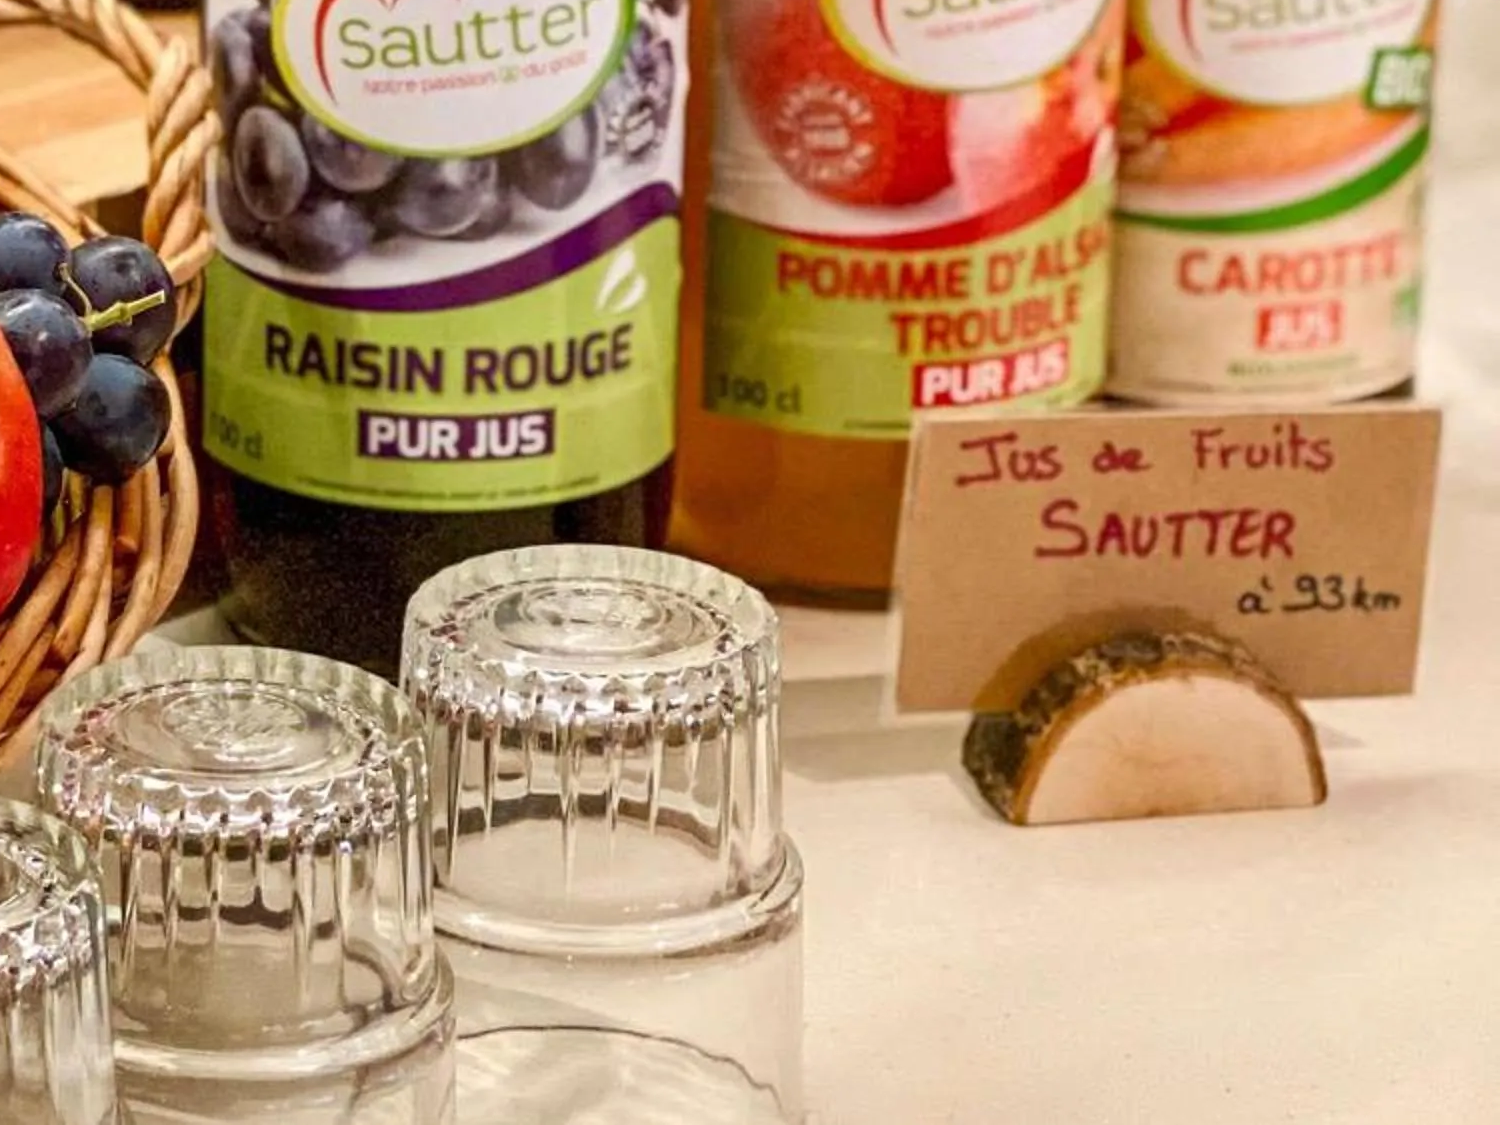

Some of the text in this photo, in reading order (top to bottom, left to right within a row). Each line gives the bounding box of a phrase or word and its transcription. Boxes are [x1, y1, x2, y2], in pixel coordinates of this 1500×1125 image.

[777, 249, 971, 301] POMME
[890, 283, 1082, 357] TROUBLE
[265, 323, 634, 394] RAISIN ROUGE
[920, 340, 1067, 405] PUR JUS
[367, 414, 548, 459] PUR JUS
[956, 425, 1336, 487] Jus de Fruits
[1034, 498, 1297, 559] SAUTTER
